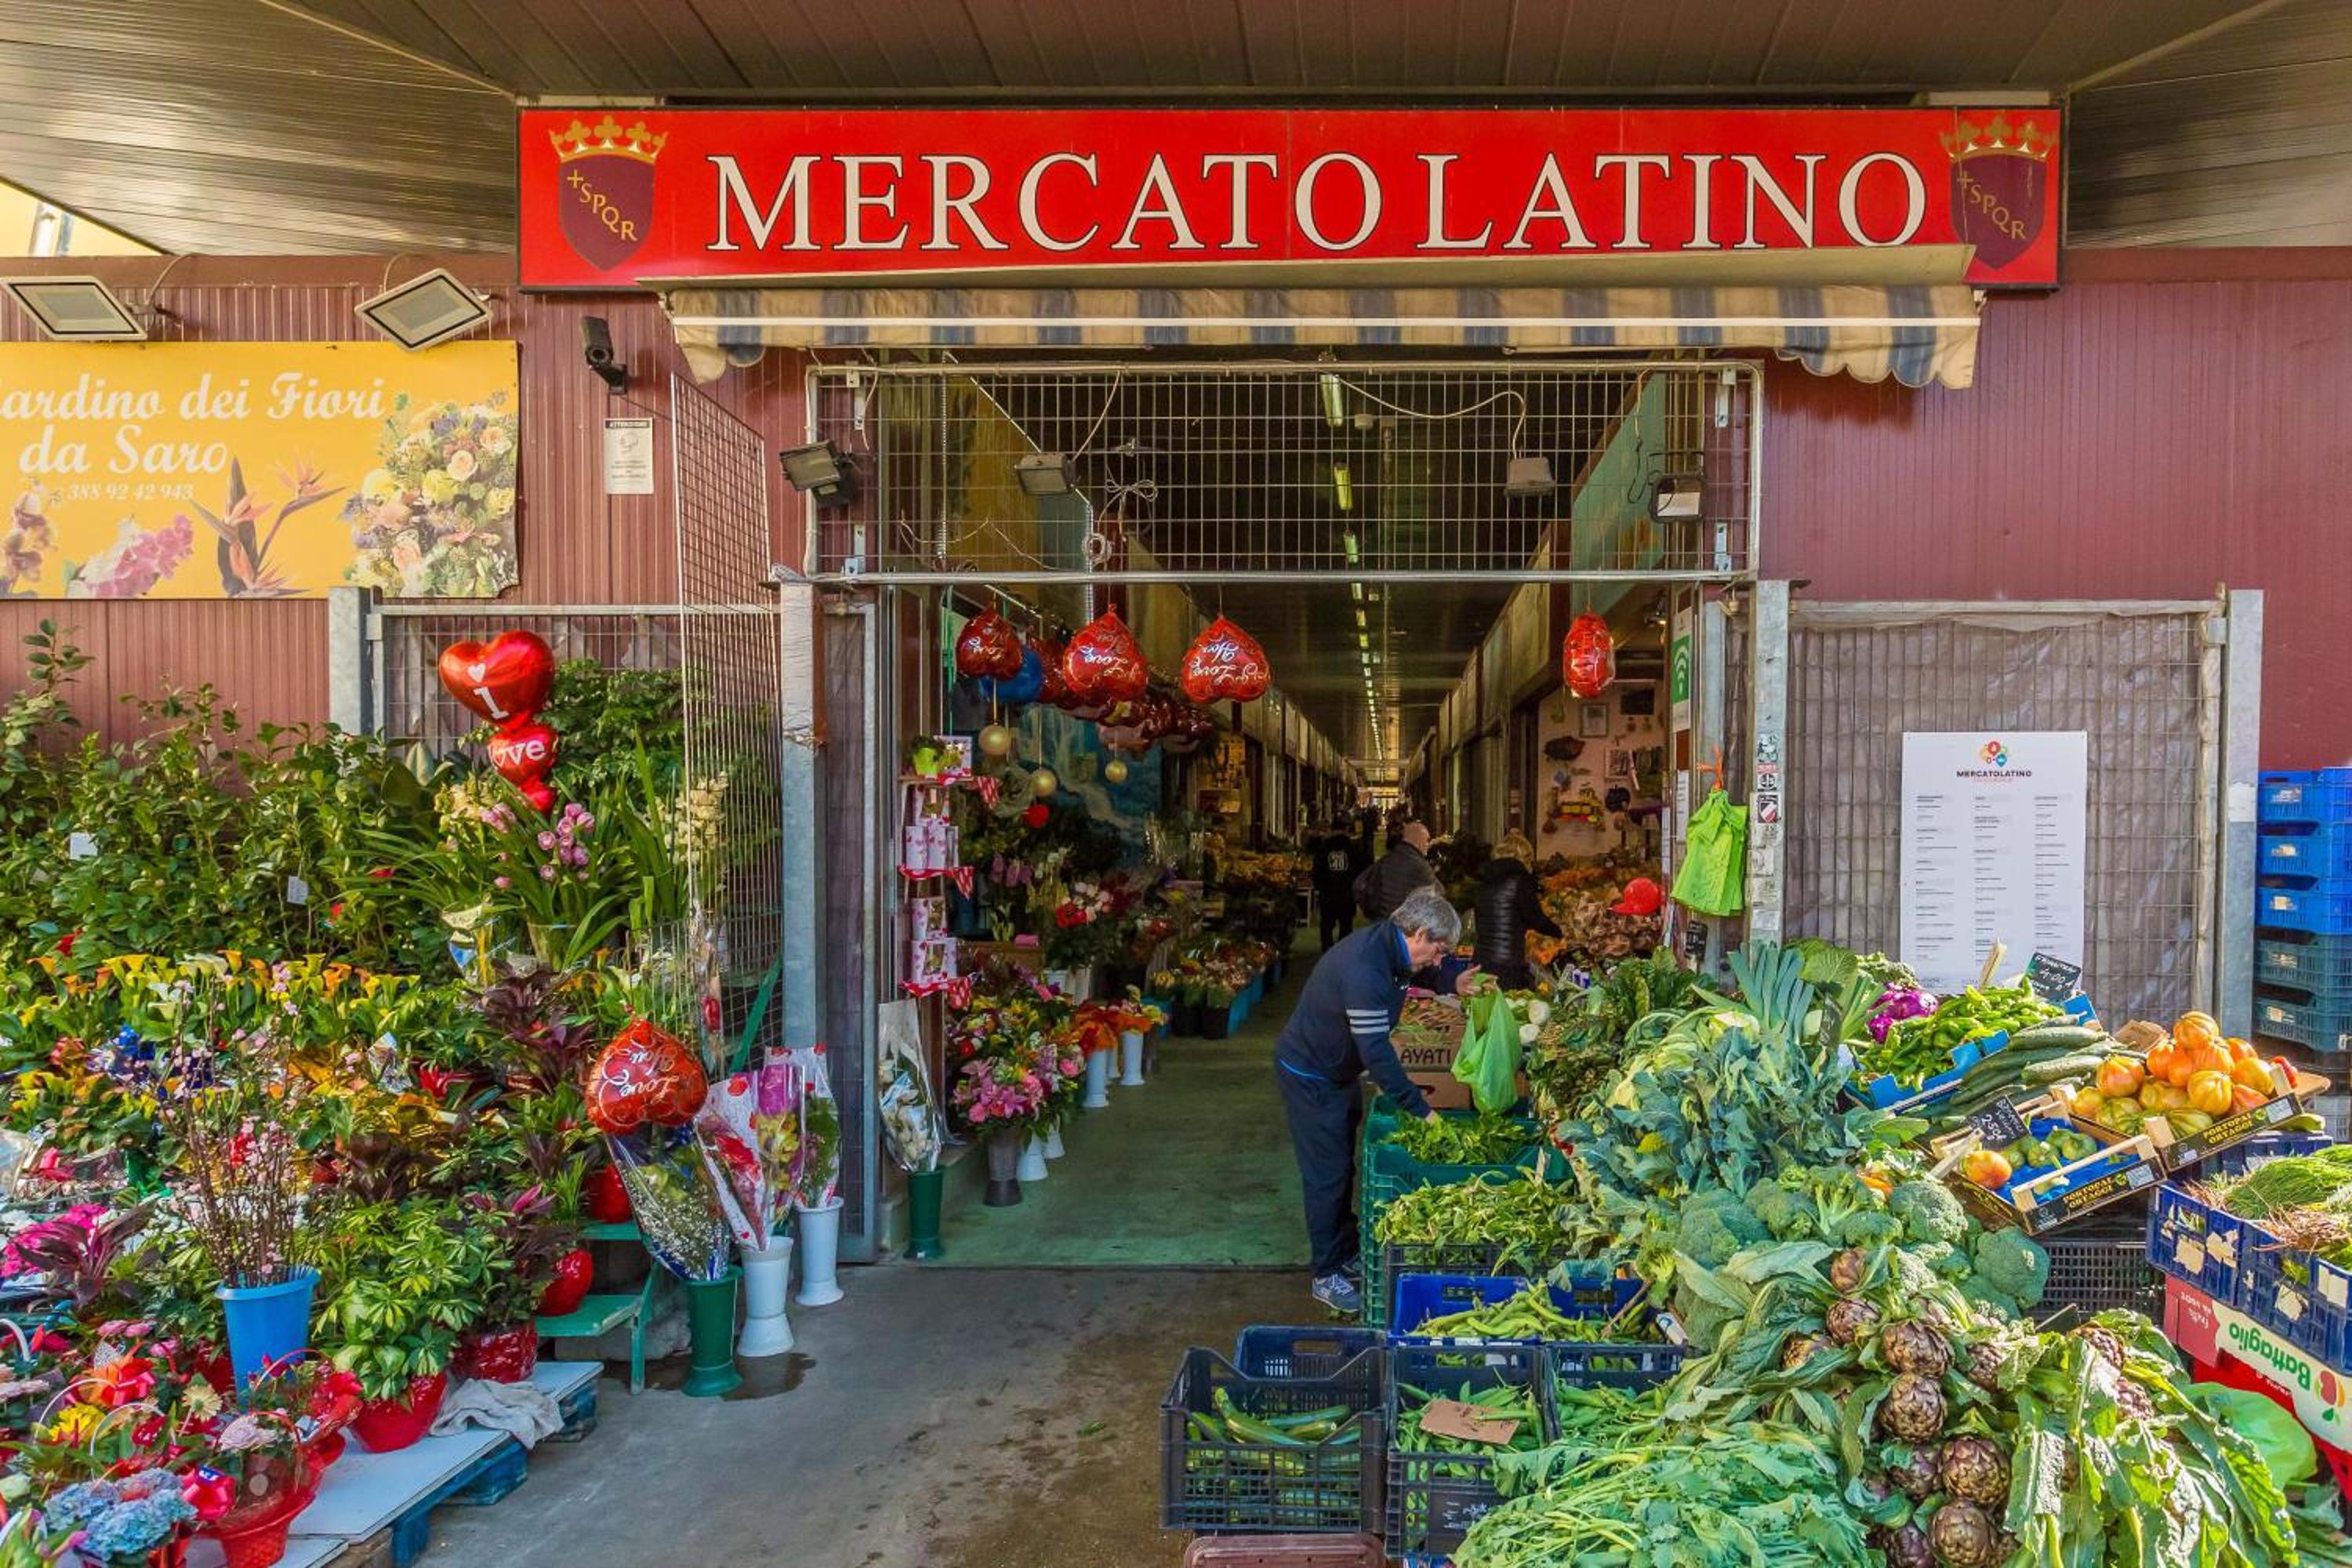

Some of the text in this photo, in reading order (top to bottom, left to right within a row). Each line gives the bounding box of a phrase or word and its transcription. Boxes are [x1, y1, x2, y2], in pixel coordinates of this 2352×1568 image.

[579, 183, 638, 241] SPQR
[706, 151, 1927, 251] MERCATO LATINO
[1969, 184, 2027, 240] SPQR
[0, 372, 386, 419] ardino dei Fiori
[18, 423, 228, 474] da Saro
[67, 482, 101, 500] 388
[106, 482, 129, 500] 92
[160, 482, 196, 500] 943
[619, 1075, 680, 1105] Love
[2228, 1323, 2310, 1392] Battaglio
